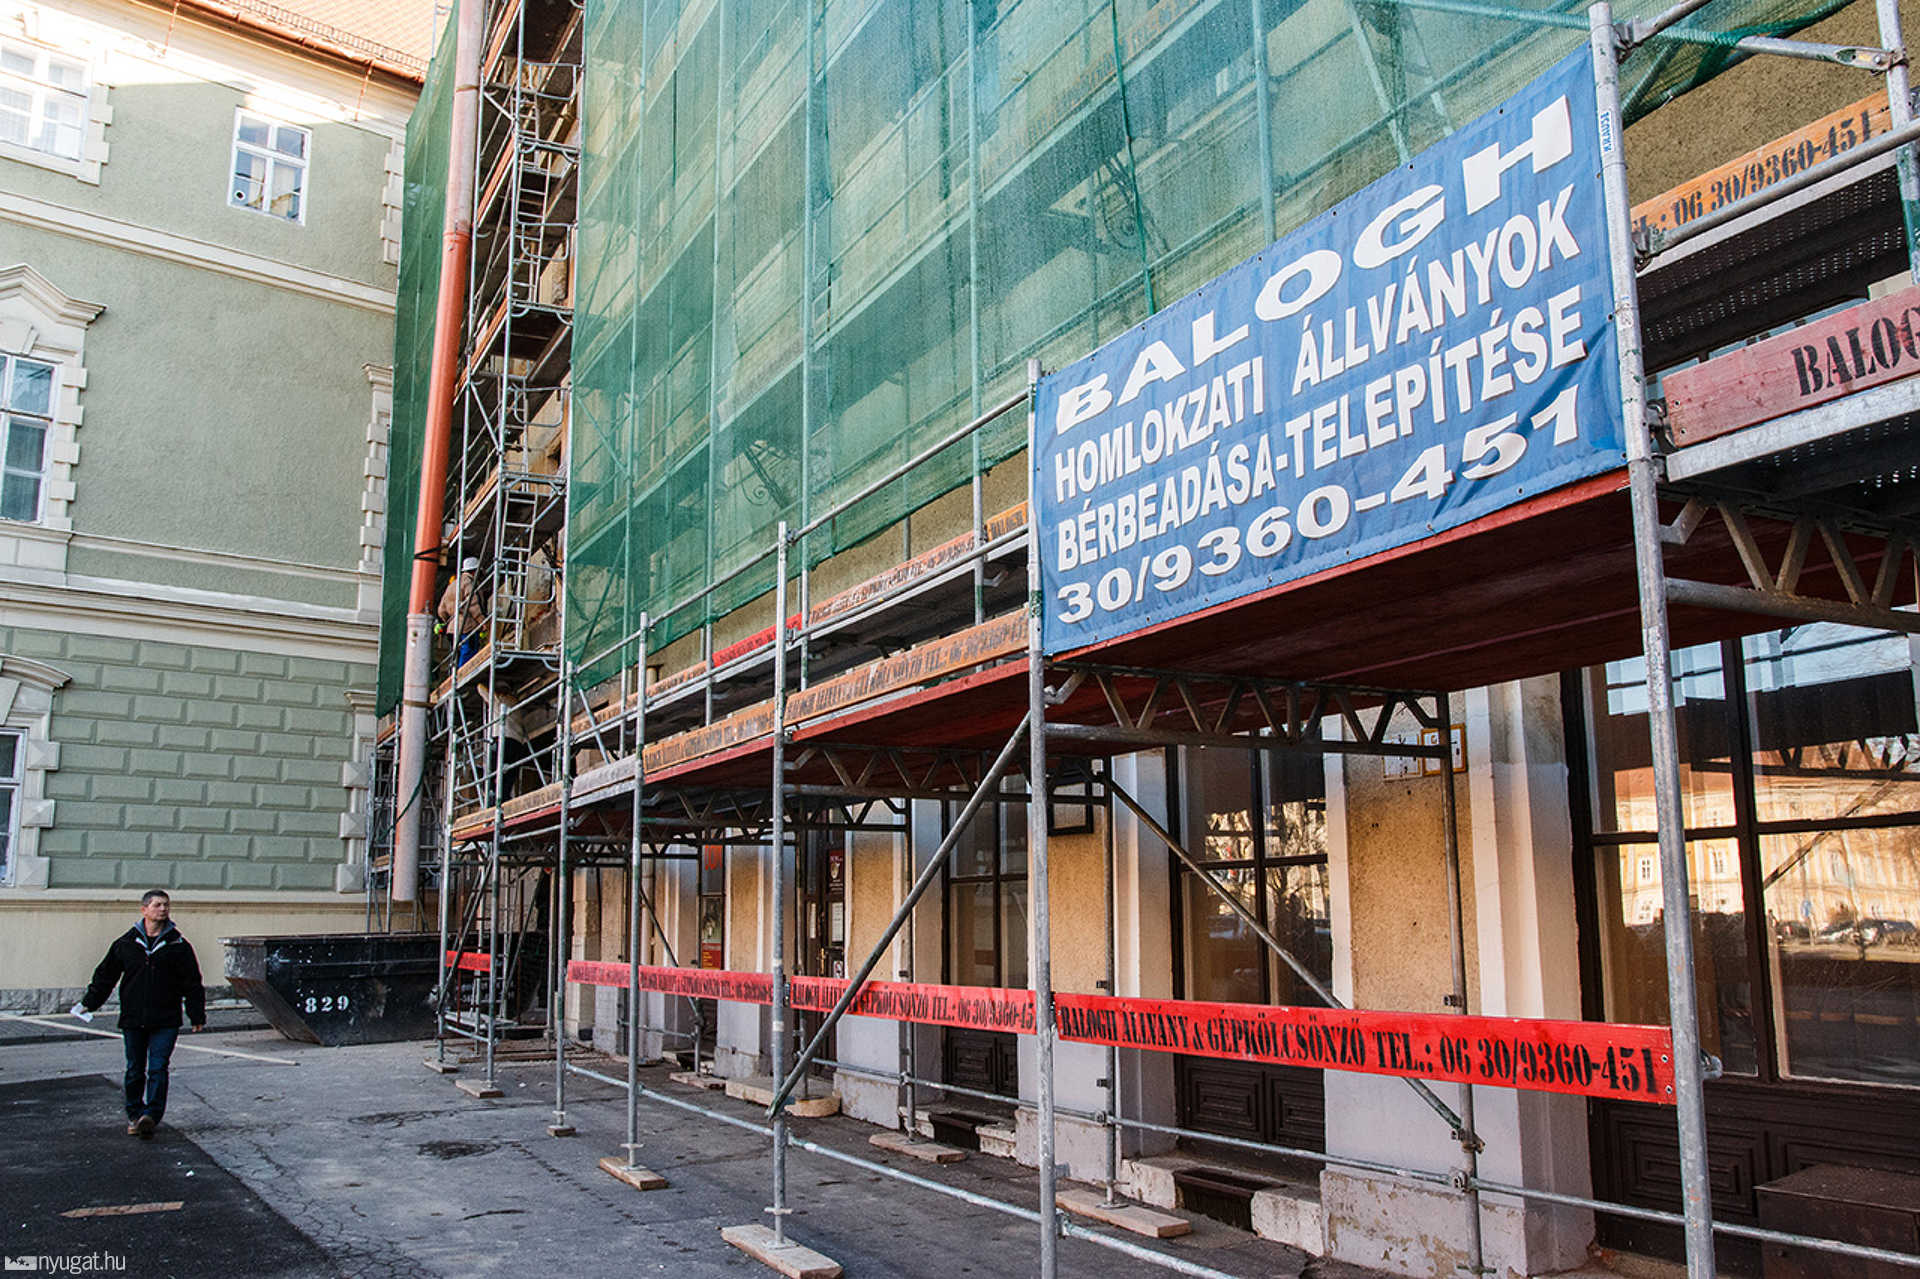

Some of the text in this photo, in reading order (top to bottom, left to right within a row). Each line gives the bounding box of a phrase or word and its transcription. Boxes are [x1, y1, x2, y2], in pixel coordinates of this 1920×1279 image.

[1672, 110, 1871, 226] 06 30/9360-451
[1055, 184, 1581, 504] HOMLOKZATI ÁLLVÁNYOK
[1056, 94, 1573, 436] BALOGH
[1057, 384, 1580, 624] 30/9360-451
[1058, 285, 1587, 573] BÉRBEADÁSA-TELEPÍTÉSE
[305, 995, 349, 1014] 829
[973, 999, 1037, 1030] 30/9360-45
[1061, 1005, 1118, 1041] BALOGH
[1122, 1002, 1190, 1049] ÁLLVÁNY
[1373, 1031, 1433, 1073] TEL.:
[1440, 1034, 1471, 1075] 06
[1478, 1037, 1658, 1094] 30/9360-451
